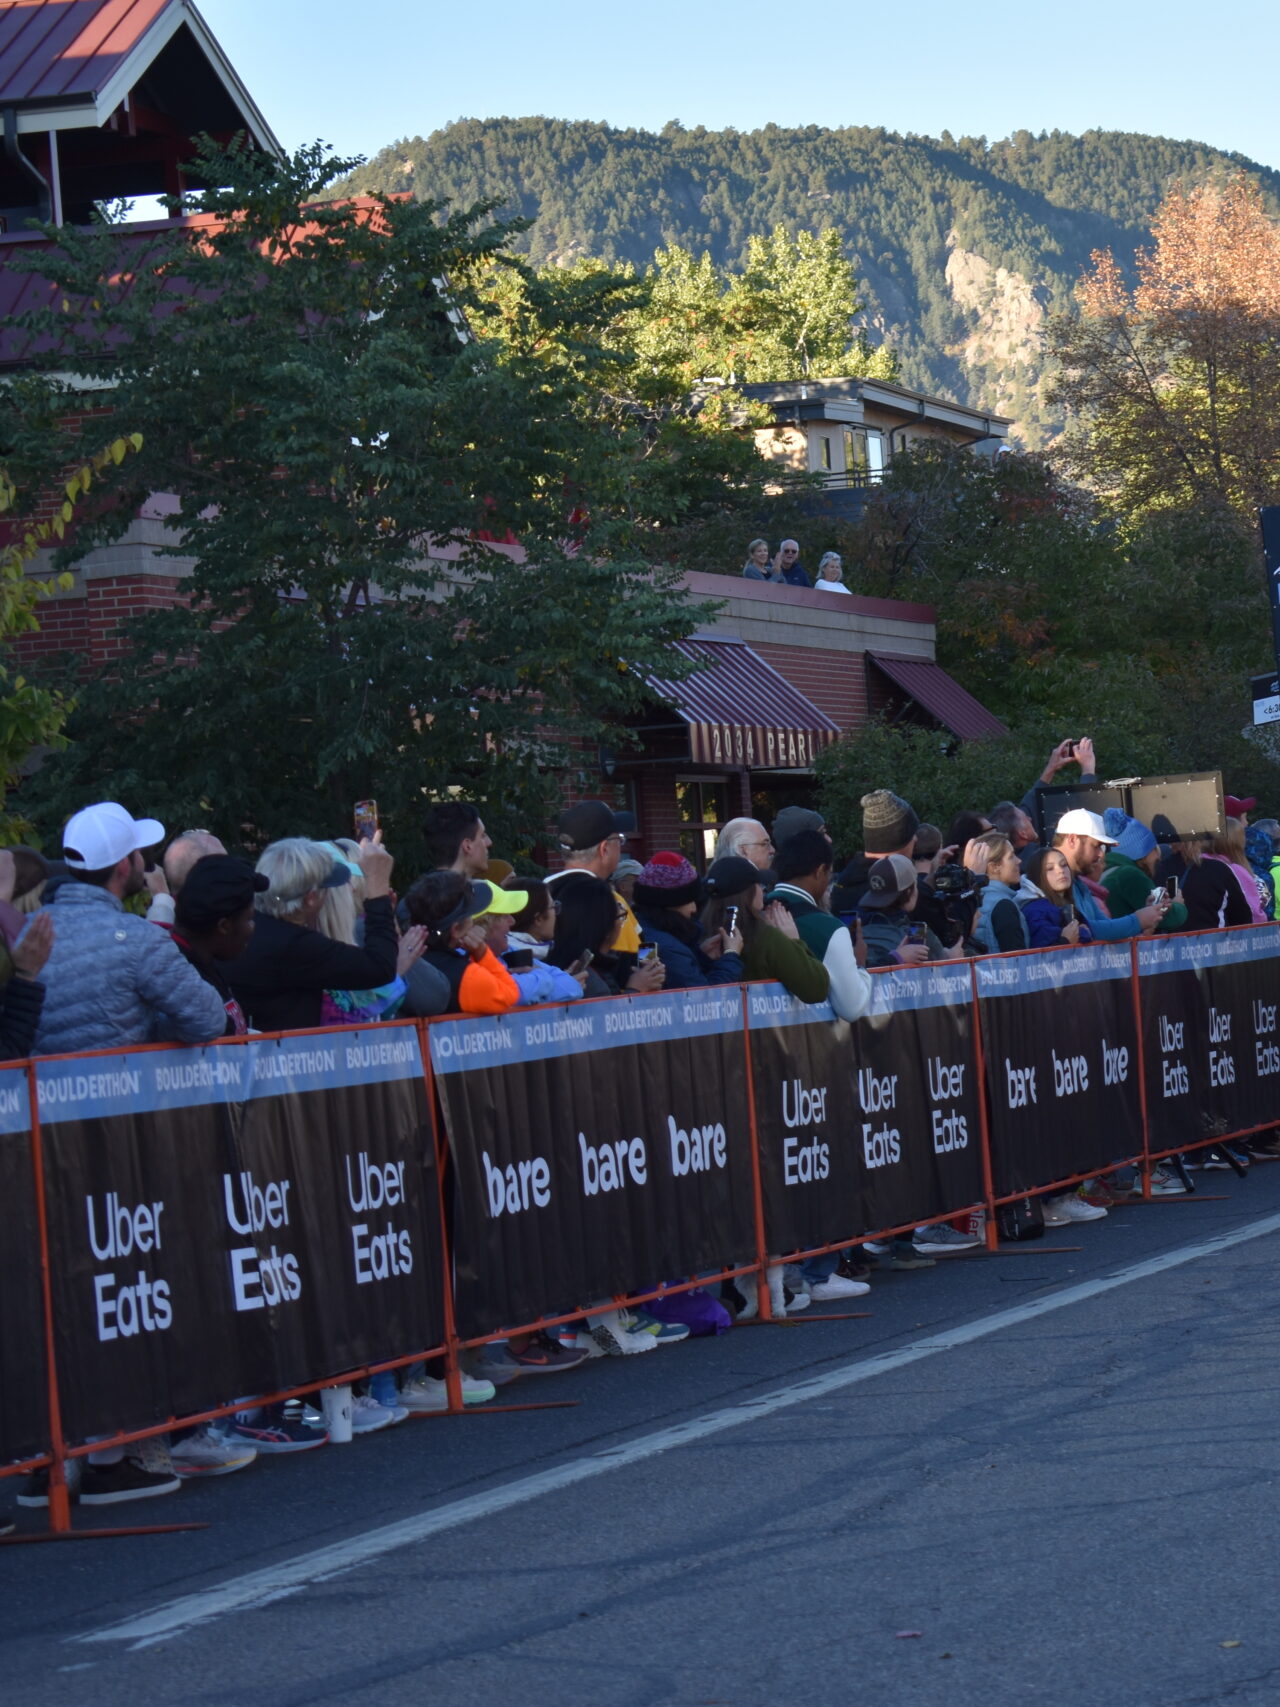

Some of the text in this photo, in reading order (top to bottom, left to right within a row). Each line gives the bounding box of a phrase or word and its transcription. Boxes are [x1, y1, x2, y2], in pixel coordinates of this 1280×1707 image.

[713, 729, 815, 761] 2034 PEARL
[604, 1006, 672, 1033] BOULDERTHON
[1159, 1015, 1184, 1053] Uber
[1209, 1007, 1231, 1043] Uber
[1253, 999, 1277, 1035] Uber
[928, 1056, 965, 1101] Uber
[1052, 1048, 1089, 1097] bare
[1162, 1059, 1189, 1097] Eats
[1209, 1050, 1236, 1087] Eats
[1255, 1041, 1280, 1077] Eats
[37, 1070, 138, 1104] BOULDERTHON
[782, 1079, 827, 1128] Uber
[858, 1067, 898, 1114] Uber
[862, 1122, 900, 1169] Eats
[931, 1108, 968, 1154] Eats
[345, 1151, 406, 1213] Uber
[482, 1114, 727, 1218] bare bare bare
[783, 1136, 830, 1185] Eats
[86, 1192, 164, 1262] Uber
[223, 1171, 290, 1236] Uber
[351, 1222, 413, 1285] Eats
[230, 1245, 301, 1312] Eats
[94, 1269, 173, 1342] Eats
